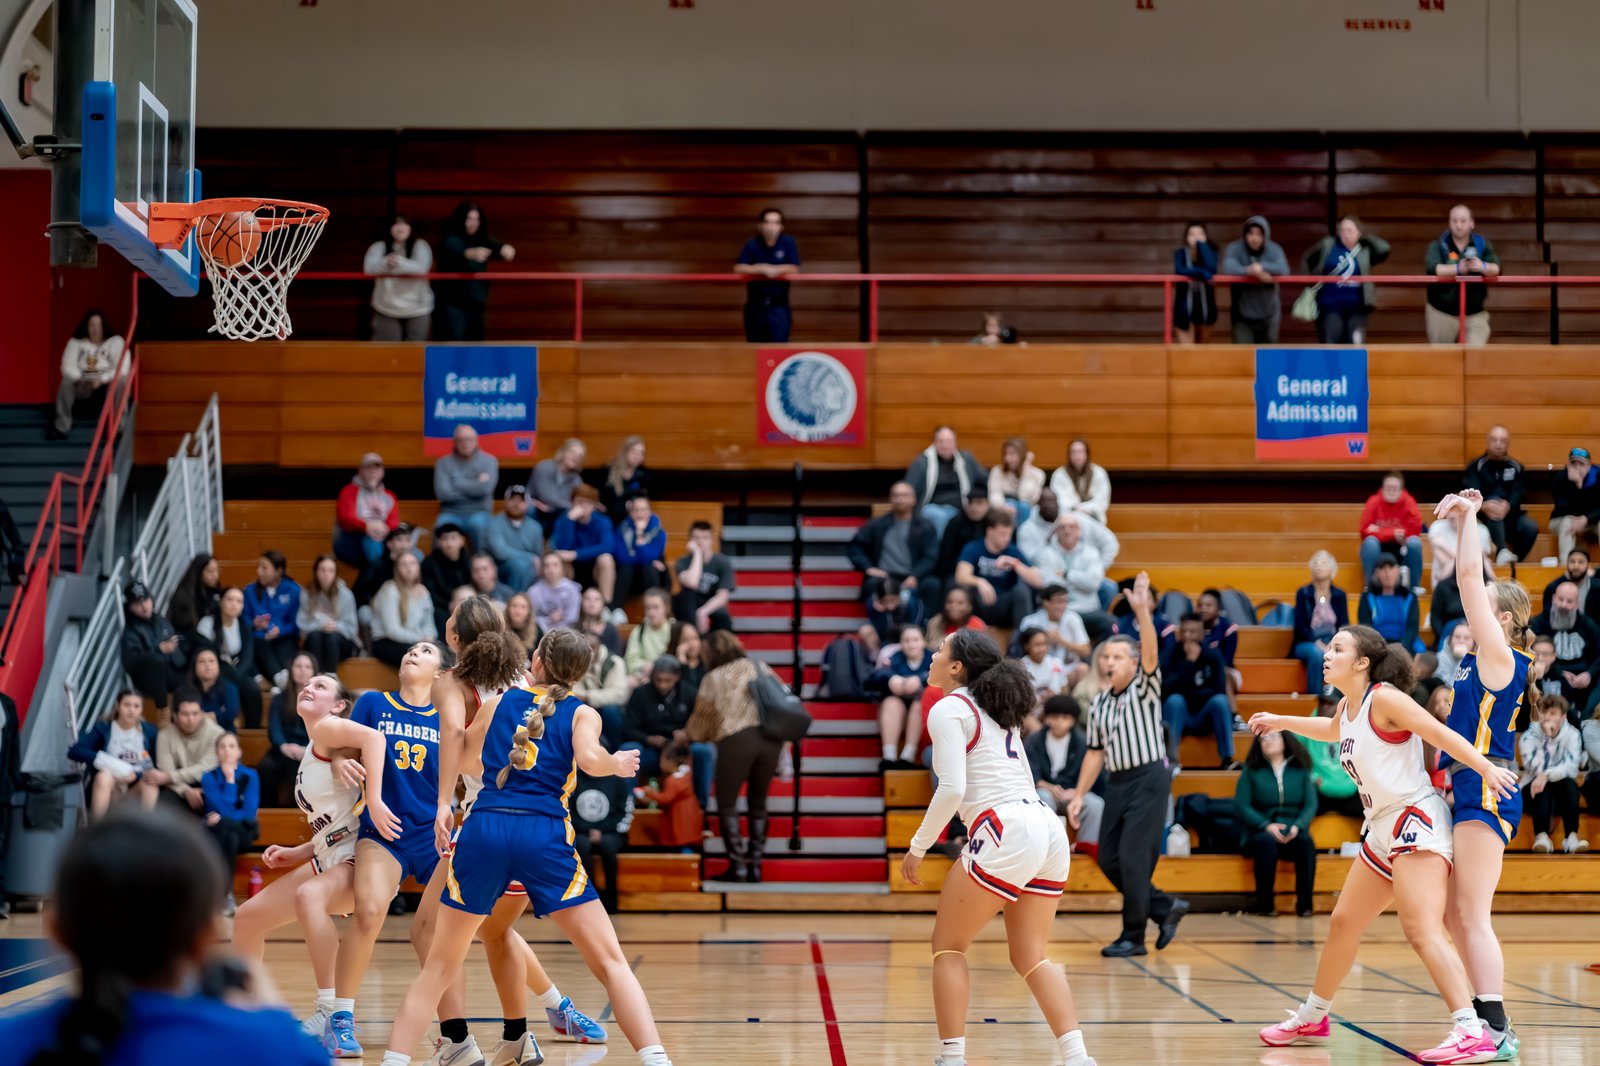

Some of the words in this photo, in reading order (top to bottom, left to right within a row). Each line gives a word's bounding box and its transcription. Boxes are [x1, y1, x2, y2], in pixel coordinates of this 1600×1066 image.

[445, 372, 517, 395] General
[1277, 374, 1349, 397] General
[434, 398, 527, 420] Admission
[1266, 400, 1358, 423] Admission
[394, 740, 428, 772] 33
